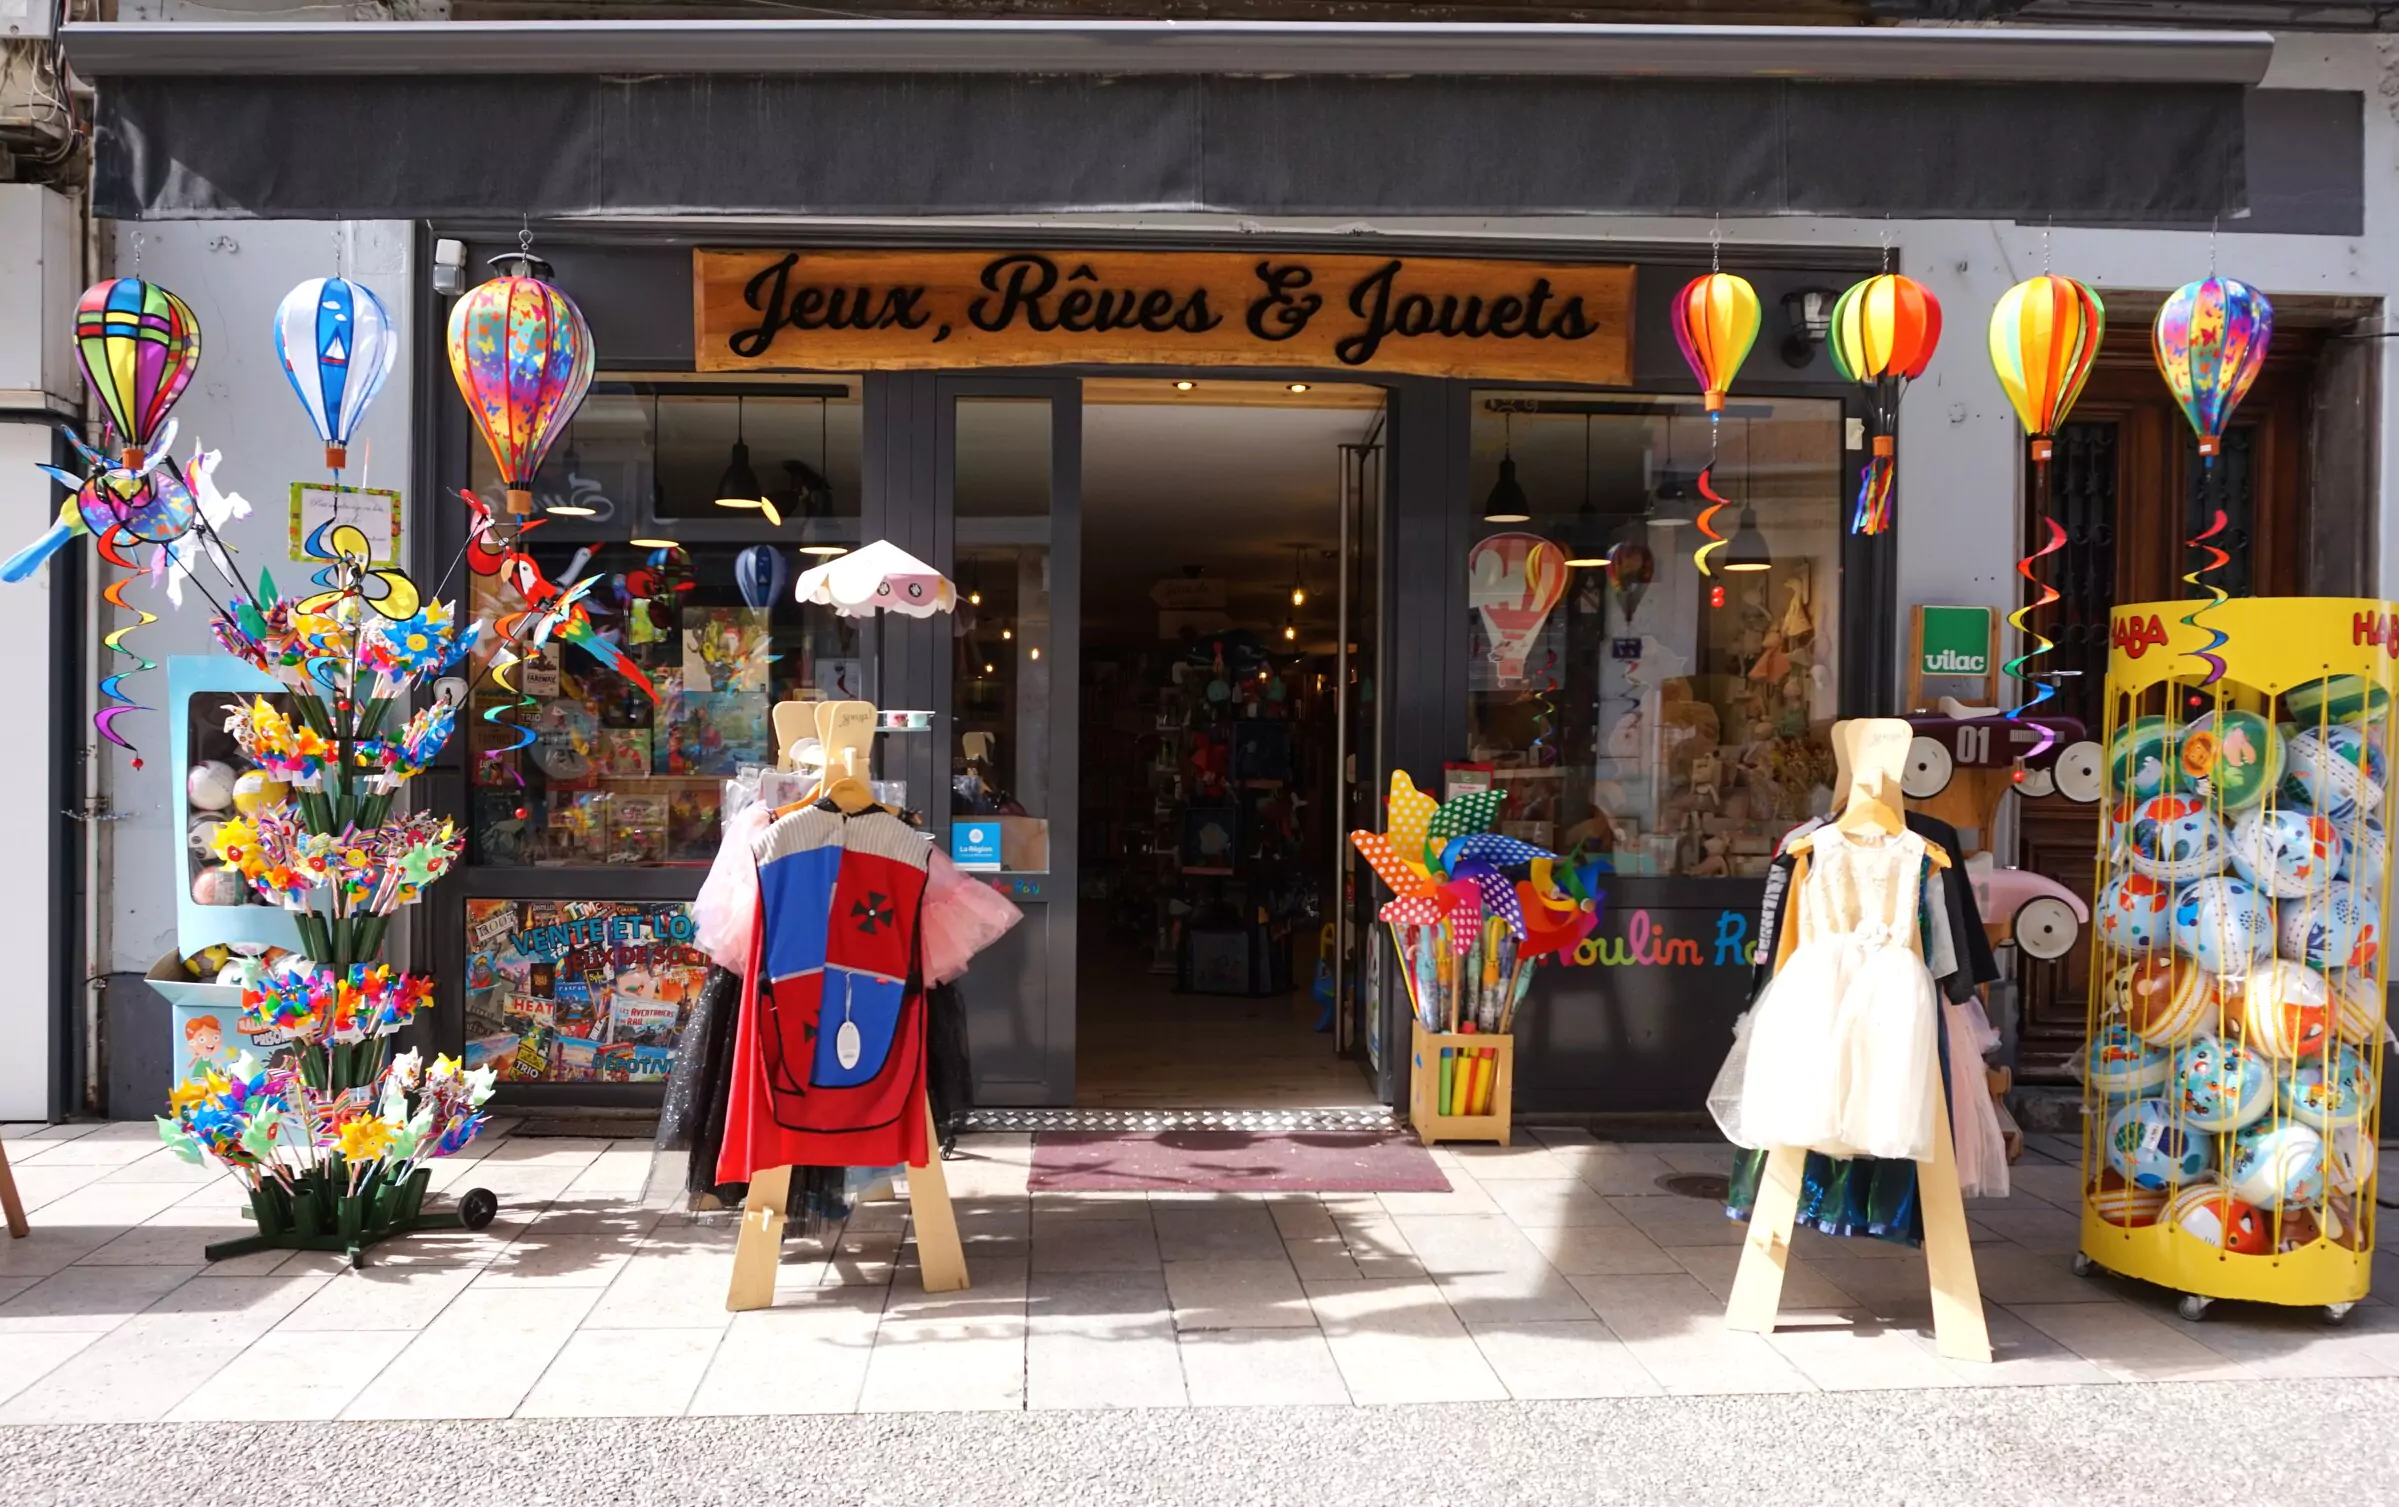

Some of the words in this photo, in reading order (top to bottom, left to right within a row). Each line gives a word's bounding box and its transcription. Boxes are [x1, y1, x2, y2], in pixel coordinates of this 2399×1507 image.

[729, 253, 952, 357] Jeux,
[968, 254, 1224, 332] Rêves
[1246, 260, 1323, 341] &
[1335, 260, 1599, 365] Jouets
[2353, 610, 2399, 660] HAB
[1925, 649, 1985, 671] vilac
[521, 713, 541, 721] TRIO
[1956, 725, 1990, 763] 01
[510, 918, 605, 956] VENTE
[612, 915, 644, 940] ET
[653, 914, 700, 941] LO
[563, 946, 615, 979] JEUX
[620, 946, 649, 965] DE
[513, 997, 554, 1015] HEAT
[515, 1061, 540, 1079] TRIO
[592, 1051, 674, 1074] DÉPOT/V
